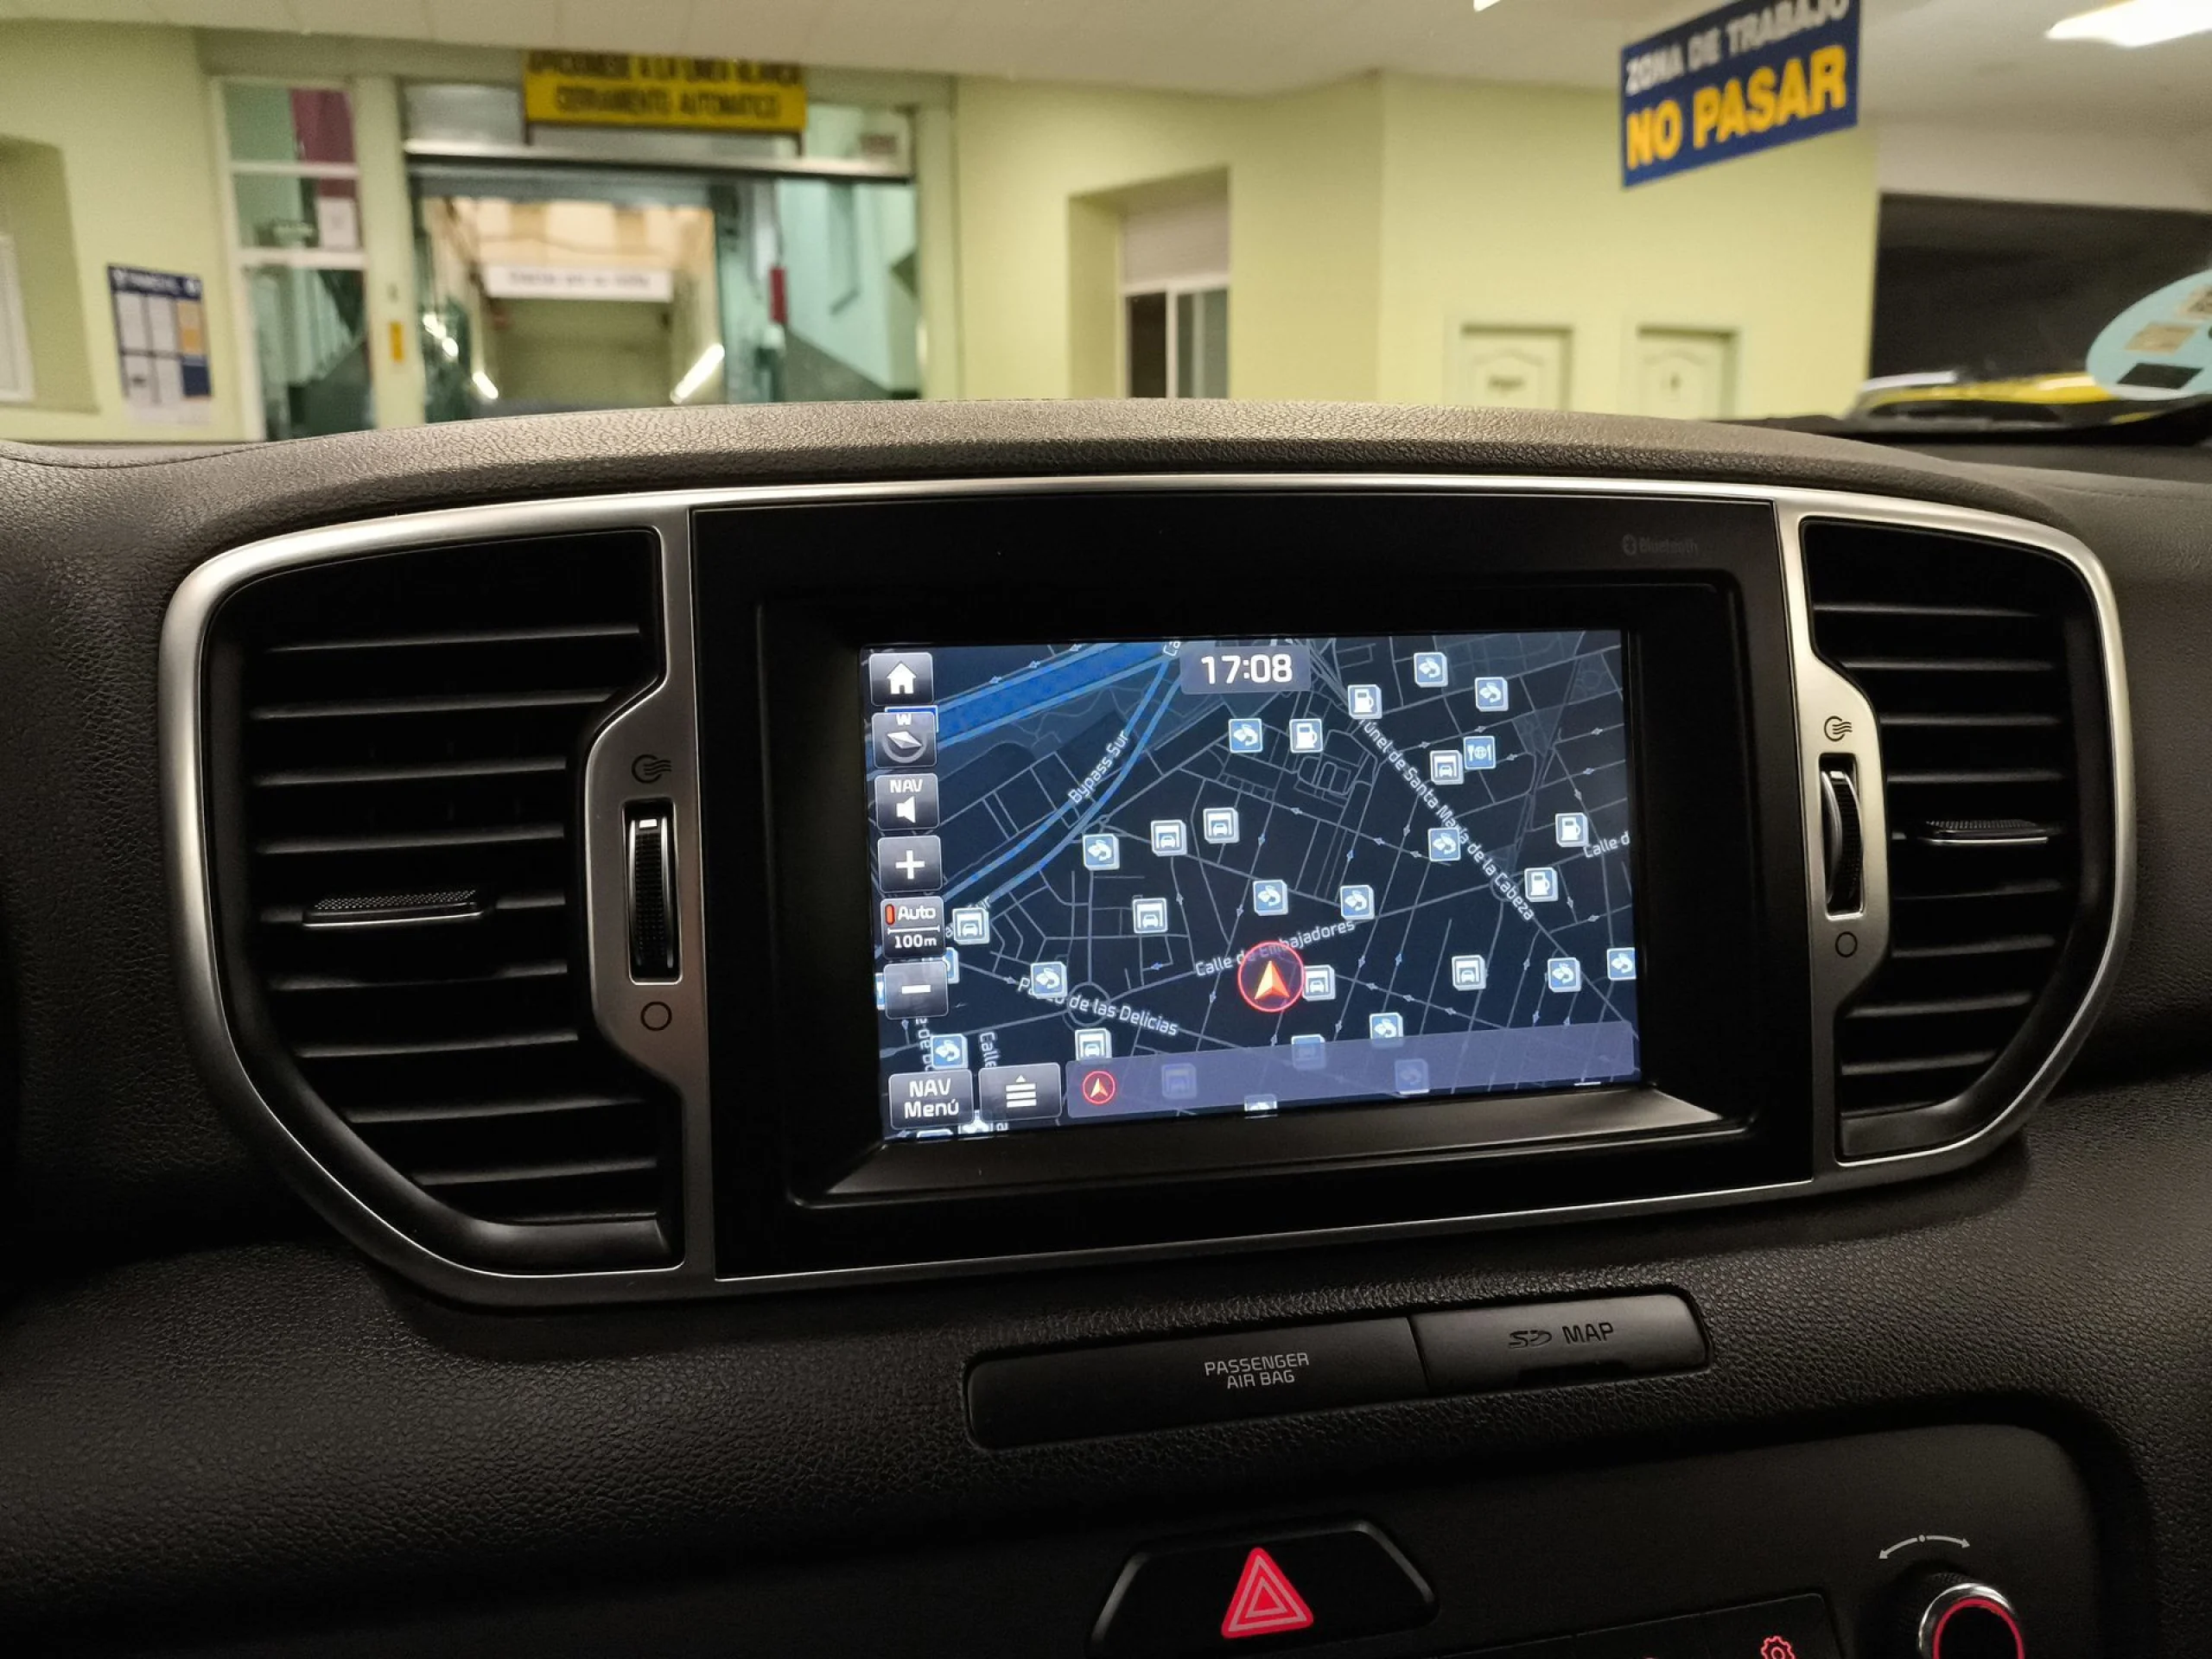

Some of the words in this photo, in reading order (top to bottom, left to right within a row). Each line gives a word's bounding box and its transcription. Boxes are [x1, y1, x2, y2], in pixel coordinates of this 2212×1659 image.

[1625, 44, 1684, 97] ZONA
[1688, 27, 1721, 72] DE
[1626, 99, 1682, 169] NO
[1693, 45, 1847, 149] PASAR
[1201, 653, 1293, 684] 17:08
[896, 712, 912, 726] W
[1067, 756, 1113, 804] Bypass
[1106, 729, 1128, 758] Sur
[890, 779, 924, 793] NAV
[1389, 751, 1406, 772] de
[1403, 766, 1439, 809] Santa
[1466, 842, 1485, 863] de
[1482, 858, 1497, 876] la
[1495, 872, 1535, 921] Cabeza
[1583, 837, 1618, 858] Calle
[897, 905, 937, 921] Auto
[894, 934, 938, 949] 100m
[1195, 956, 1233, 977] Calle
[1070, 995, 1090, 1013] de
[1093, 998, 1116, 1018] las
[1119, 1005, 1179, 1036] Delicias
[909, 1077, 951, 1098] NAV
[904, 1098, 959, 1119] Menú
[1561, 1321, 1613, 1344] MAP
[1205, 1351, 1310, 1376] PASSENGER
[1227, 1373, 1256, 1389] AIR
[1260, 1369, 1295, 1386] BAG
